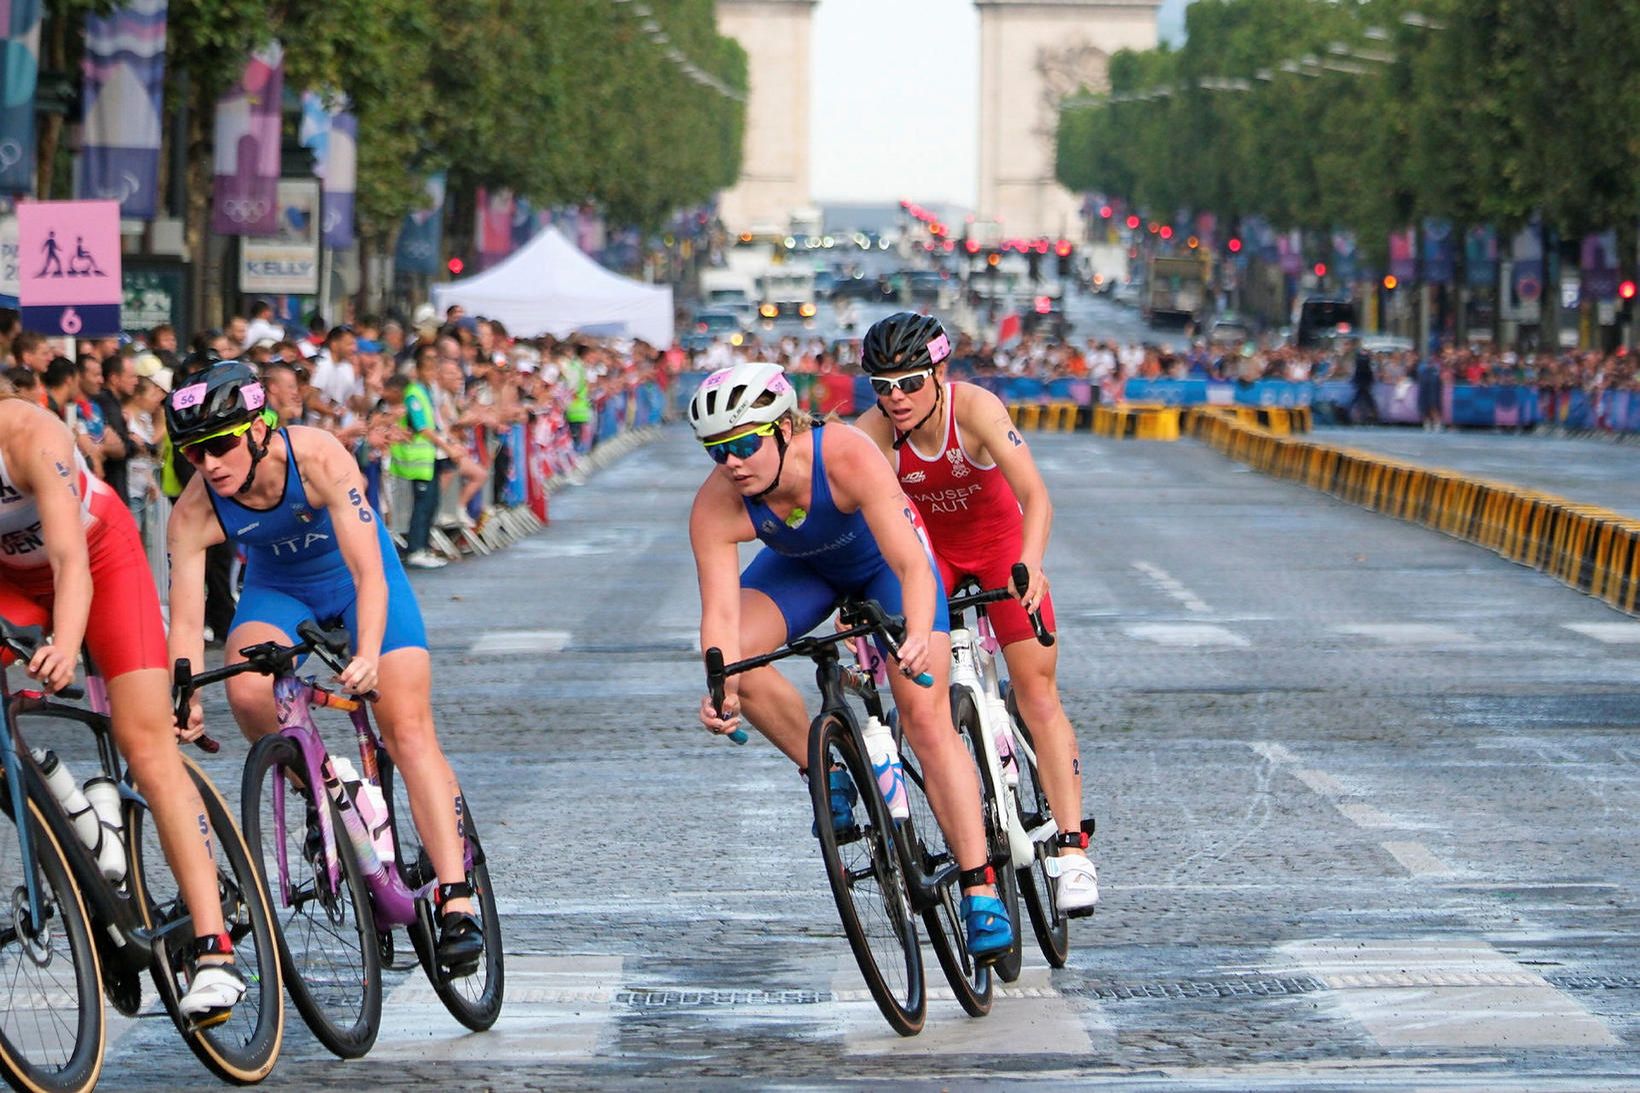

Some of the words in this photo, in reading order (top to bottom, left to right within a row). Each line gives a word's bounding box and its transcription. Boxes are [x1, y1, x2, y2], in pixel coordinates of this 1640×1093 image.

[4, 264, 20, 281] 2
[60, 308, 82, 335] 6
[180, 393, 195, 405] 56
[1007, 430, 1023, 447] 2
[55, 462, 78, 497] 51
[348, 487, 372, 523] 56
[930, 498, 968, 513] AUT
[272, 533, 329, 556] ITA
[1072, 758, 1080, 775] 2
[454, 796, 465, 838] 56
[198, 814, 213, 860] 51
